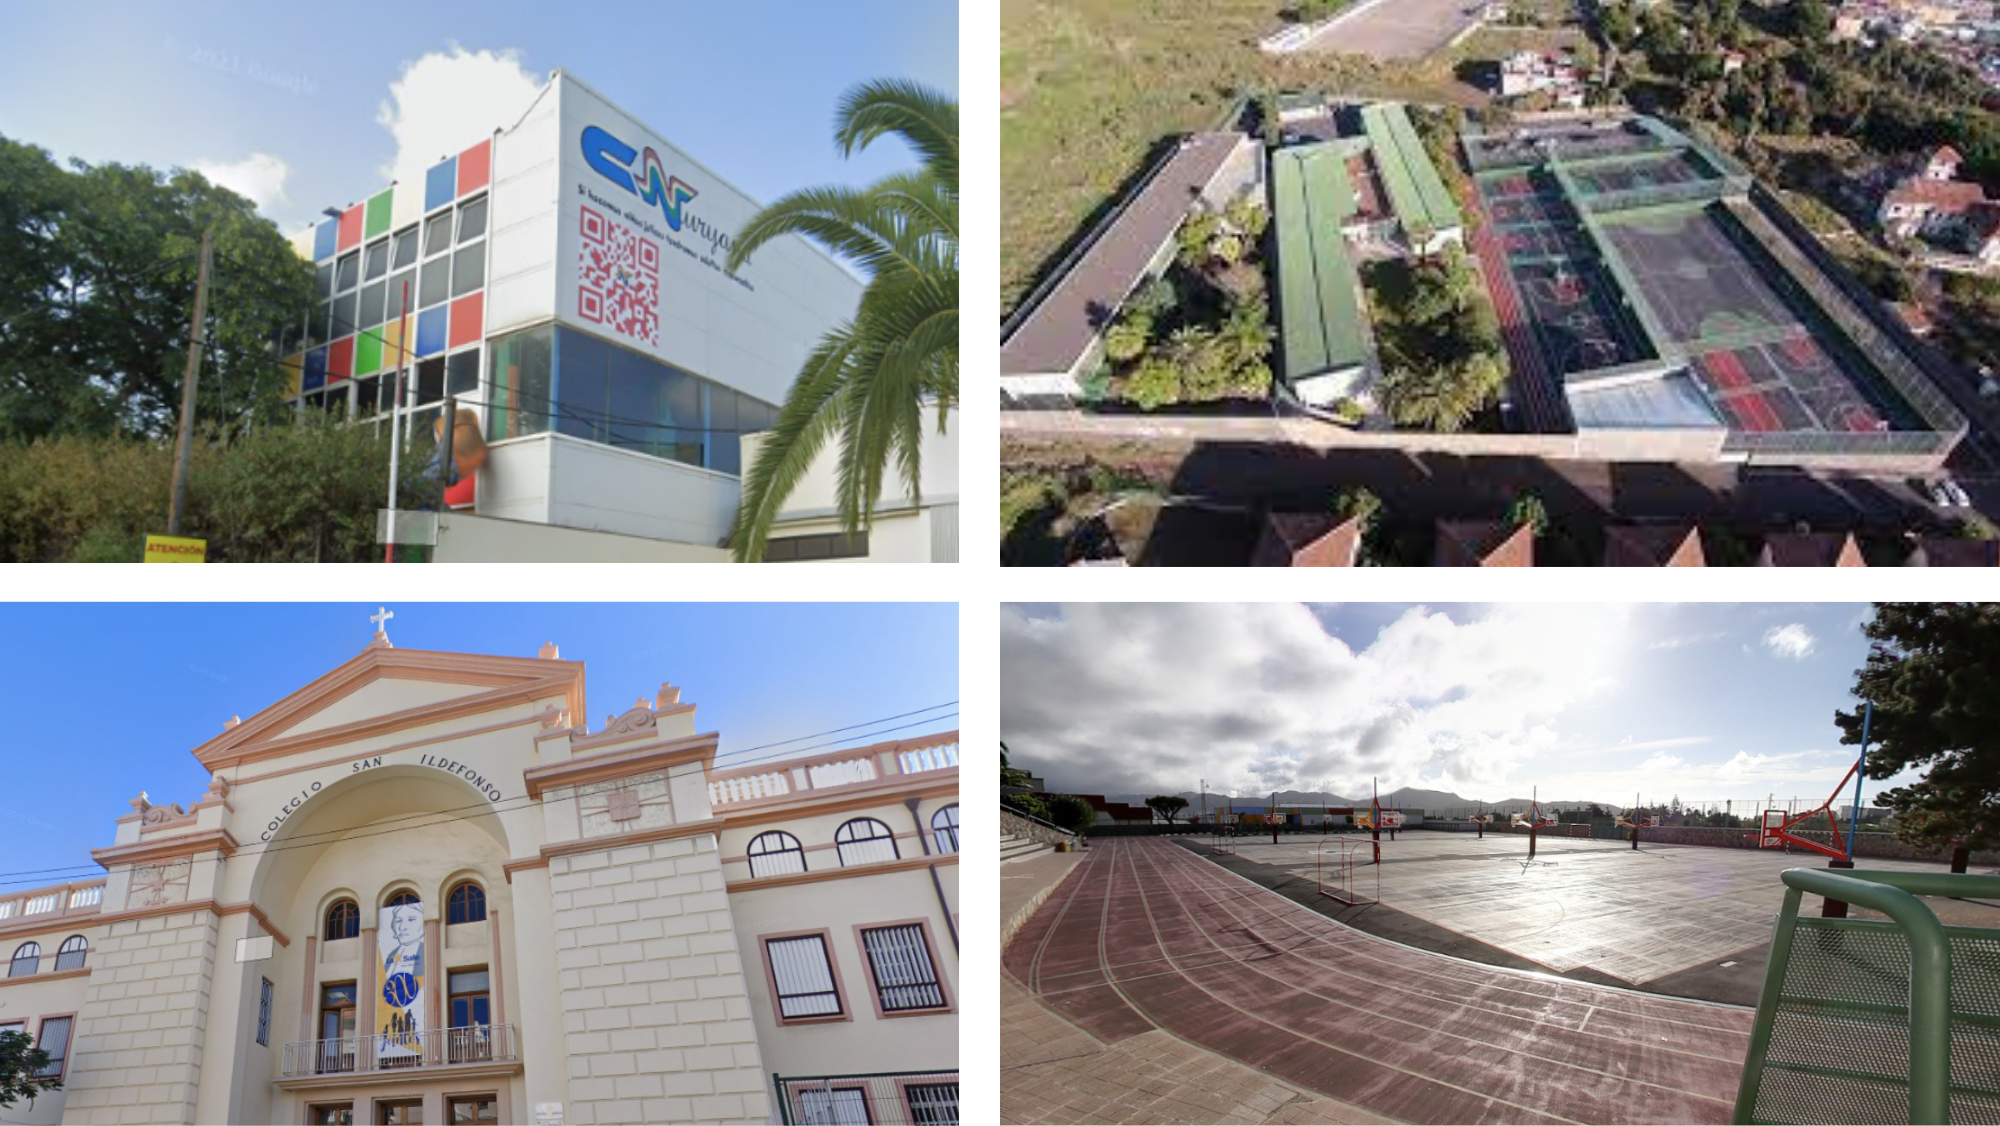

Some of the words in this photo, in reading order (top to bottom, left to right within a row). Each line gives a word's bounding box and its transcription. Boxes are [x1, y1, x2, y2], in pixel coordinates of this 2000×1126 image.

[260, 781, 323, 842] COLEGIO
[352, 756, 383, 773] SAN
[420, 754, 501, 803] ILDEFONSO
